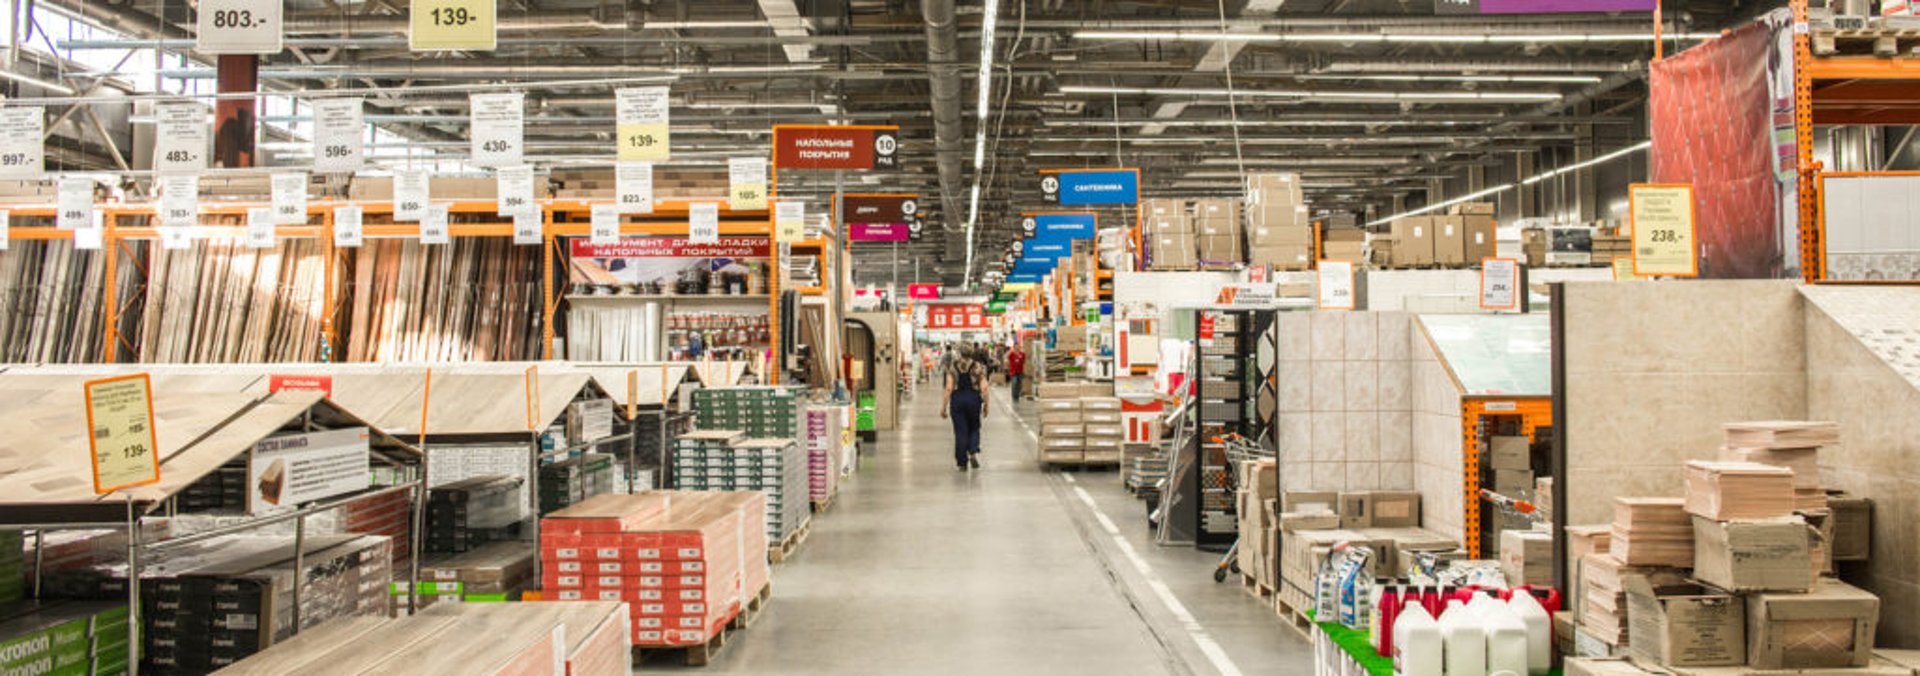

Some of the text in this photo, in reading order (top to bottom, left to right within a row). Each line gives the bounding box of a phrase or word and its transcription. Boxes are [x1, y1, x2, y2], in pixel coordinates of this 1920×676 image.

[214, 10, 267, 28] 803.-
[430, 7, 477, 26] 139-
[482, 140, 512, 152] 430-
[629, 135, 658, 147] 139-
[795, 139, 854, 147] НАПОЛЬНЫЕ
[878, 139, 893, 150] 10
[166, 151, 198, 162] 483.-
[325, 146, 352, 157] 596-
[799, 150, 850, 158] ПОКРЫТИЯ
[123, 444, 148, 458] 139-
